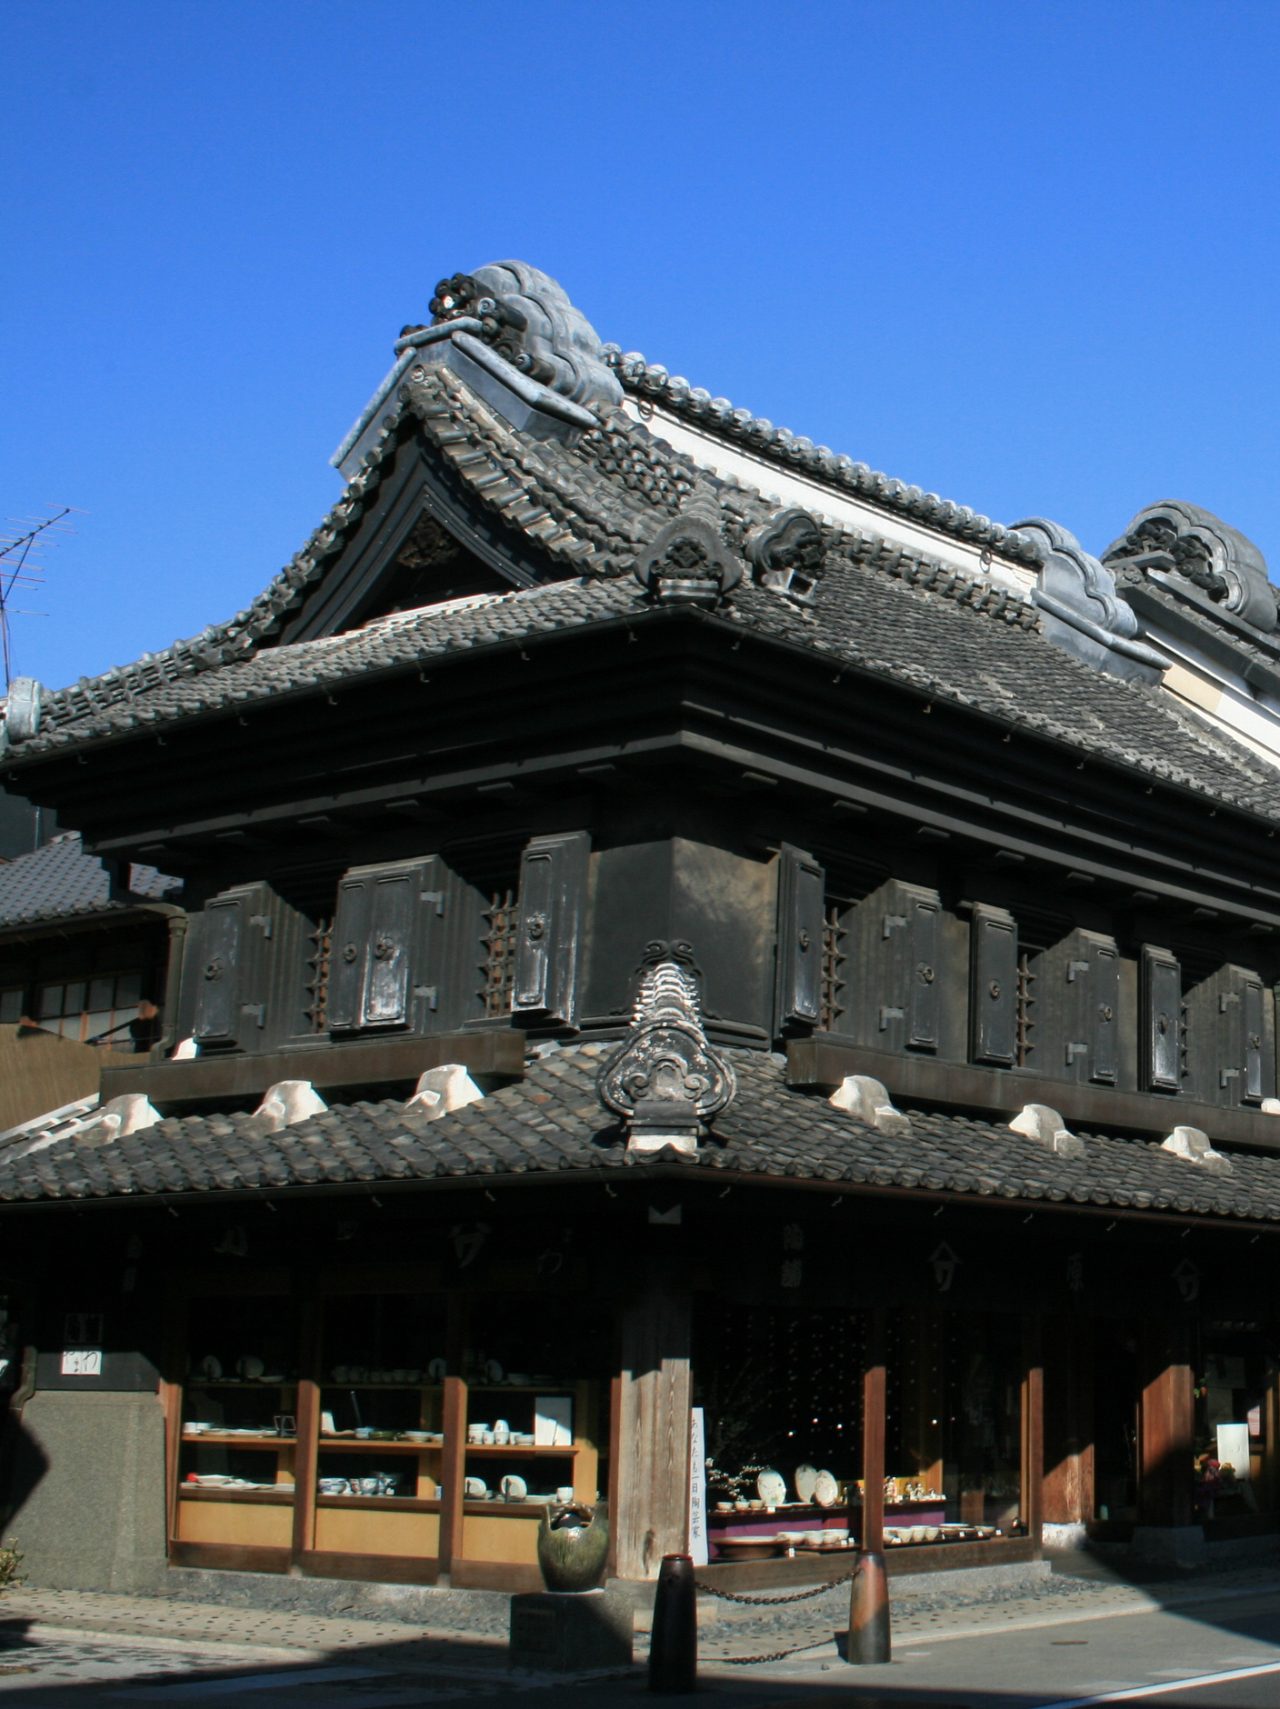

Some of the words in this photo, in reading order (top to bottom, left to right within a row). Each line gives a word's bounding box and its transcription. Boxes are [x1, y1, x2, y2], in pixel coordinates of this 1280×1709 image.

[690, 1418, 702, 1539] あなたも一日陶芸家
